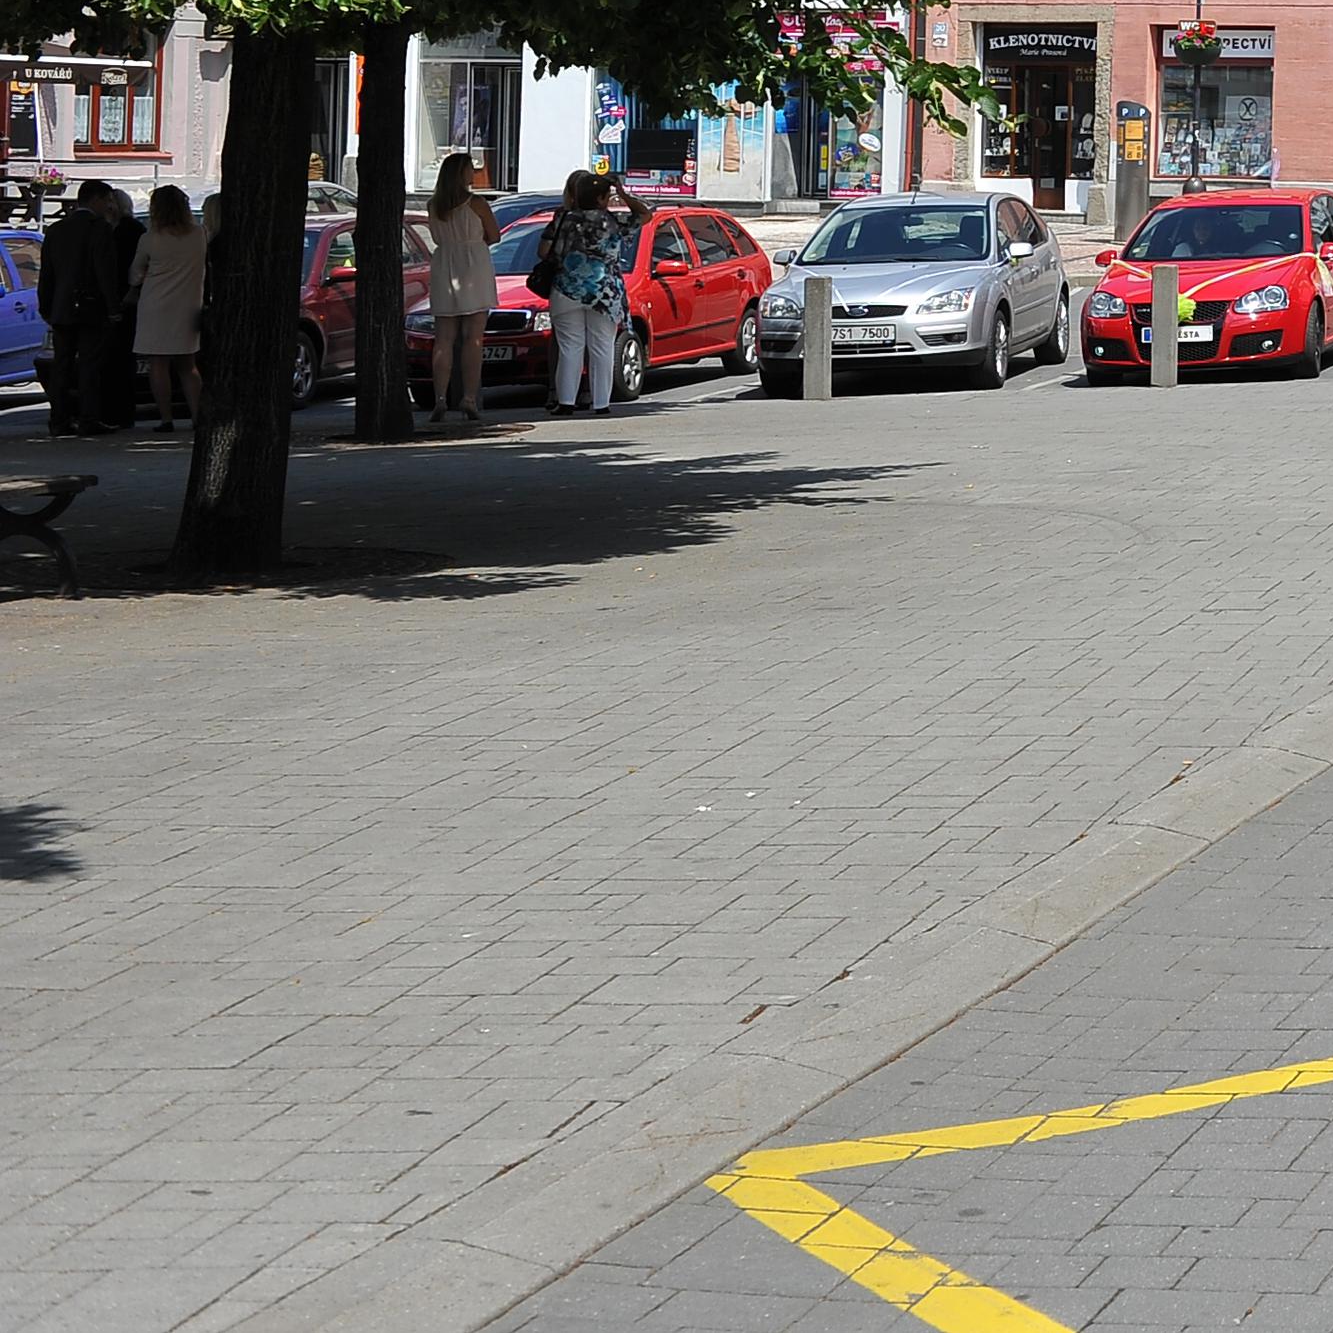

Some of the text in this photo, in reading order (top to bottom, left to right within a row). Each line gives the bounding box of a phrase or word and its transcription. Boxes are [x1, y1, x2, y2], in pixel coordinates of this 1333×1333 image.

[1180, 21, 1200, 31] WC
[1168, 34, 1272, 50] KPECTVÍ
[25, 68, 32, 78] U
[832, 327, 890, 340] 7S1 7500
[1177, 329, 1200, 339] ĚSTA
